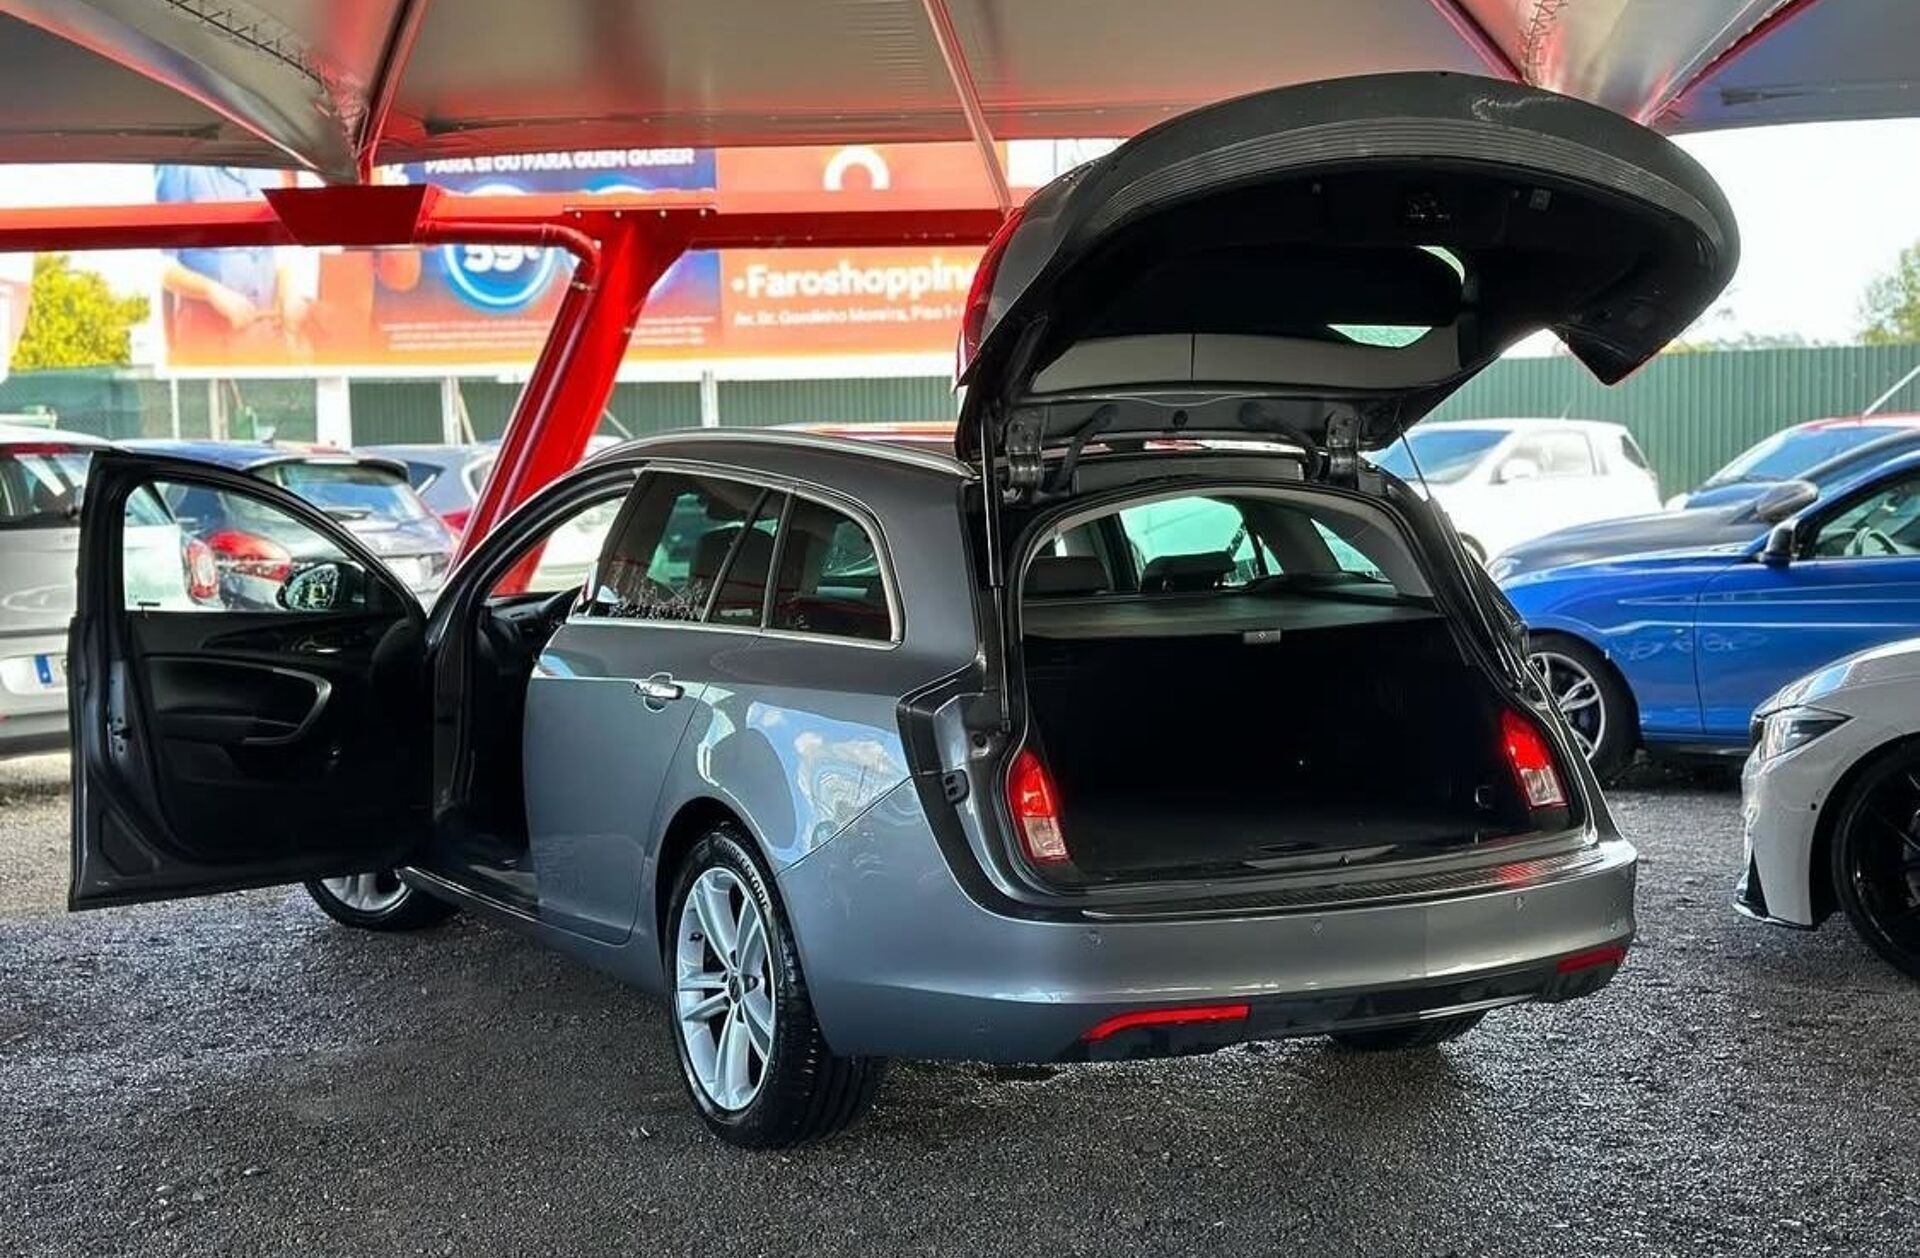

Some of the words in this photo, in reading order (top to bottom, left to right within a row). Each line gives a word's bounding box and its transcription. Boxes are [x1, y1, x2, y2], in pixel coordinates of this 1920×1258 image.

[424, 158, 474, 174] PARA
[474, 156, 492, 172] SI
[494, 154, 521, 171] OU
[522, 152, 573, 170] PARA
[573, 150, 627, 168] QUEM
